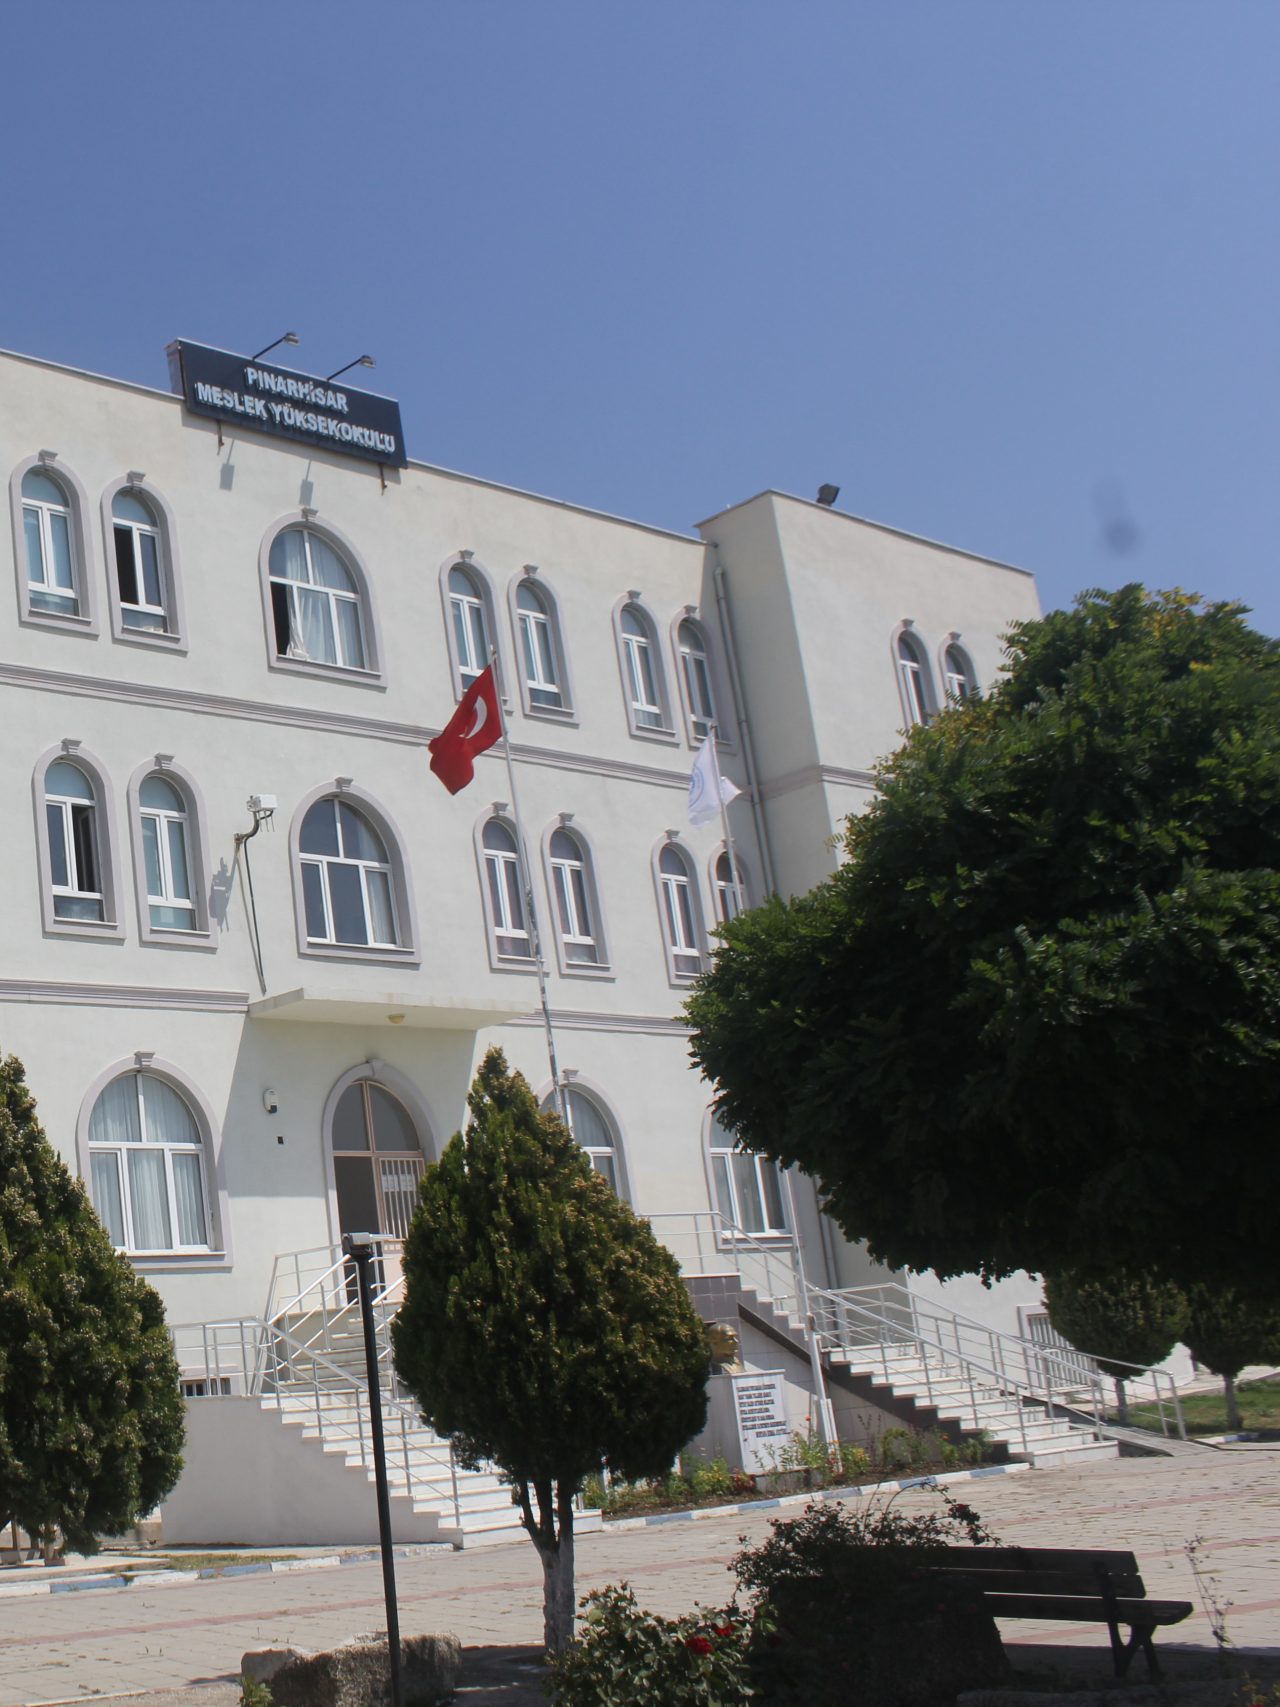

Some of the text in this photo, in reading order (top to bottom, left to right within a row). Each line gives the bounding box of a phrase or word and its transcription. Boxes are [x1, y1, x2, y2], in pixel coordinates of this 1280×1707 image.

[195, 382, 396, 453] MESLEK YÜKSEKOKULU
[246, 366, 349, 413] PINARHİSAR
